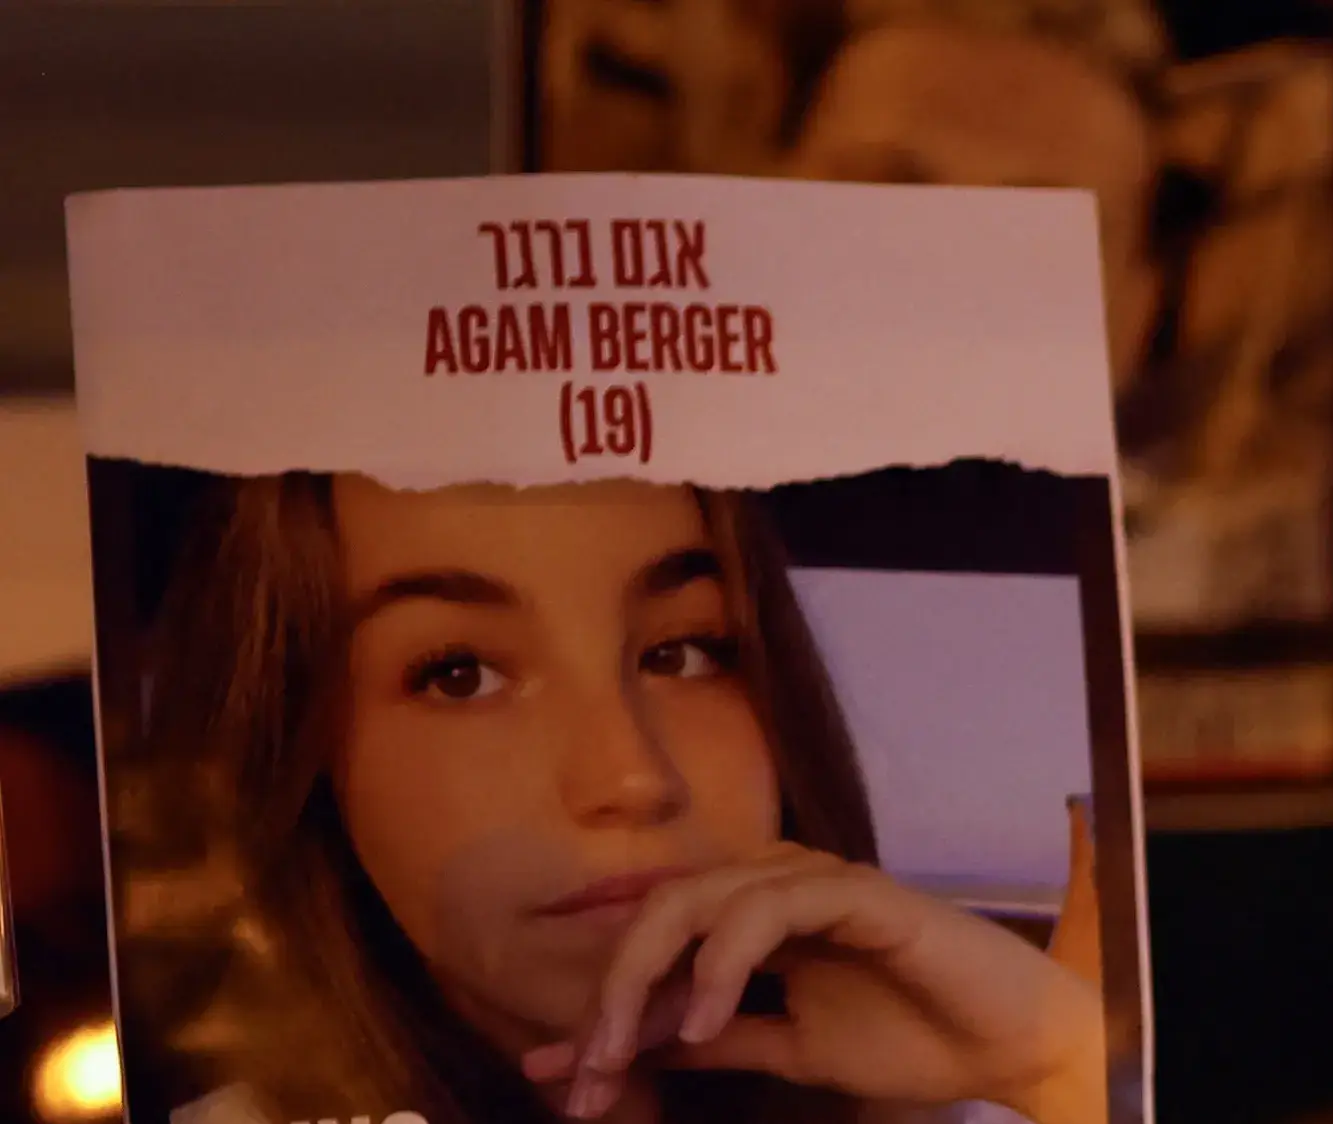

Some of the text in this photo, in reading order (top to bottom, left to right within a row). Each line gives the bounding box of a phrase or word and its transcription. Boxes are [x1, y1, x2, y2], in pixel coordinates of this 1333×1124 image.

[477, 219, 710, 291] אגם ברגר
[424, 302, 777, 376] AGAM BERGER
[559, 381, 652, 464] (19)
